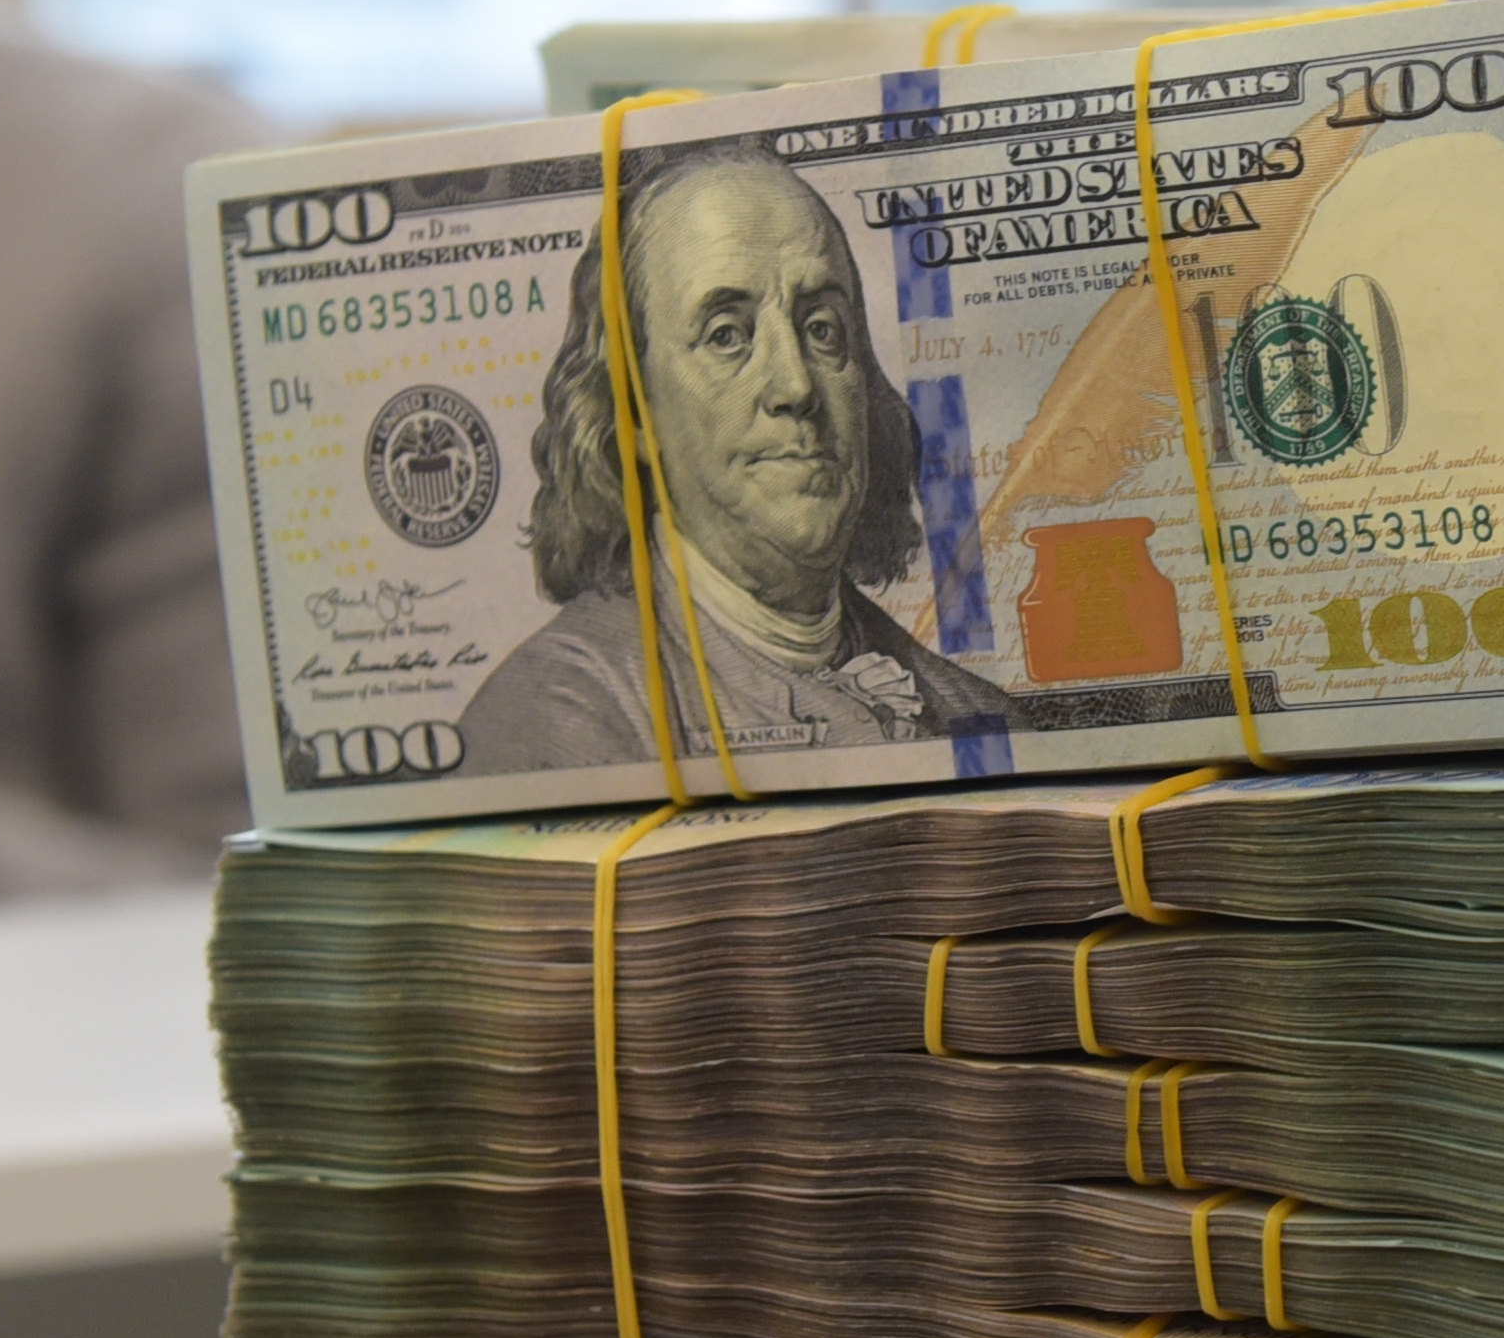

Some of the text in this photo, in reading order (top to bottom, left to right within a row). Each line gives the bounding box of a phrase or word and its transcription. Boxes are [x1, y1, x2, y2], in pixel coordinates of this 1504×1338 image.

[775, 70, 1291, 156] ONE HUNDRED DOLLARS
[1006, 130, 1139, 166] THE
[856, 137, 1305, 229] UNITED STATES
[240, 189, 395, 258] 100
[909, 221, 982, 268] OF
[256, 229, 584, 288] FEDERAL RESERVE NOTE
[994, 253, 1201, 288] THIS NOTE IS LEGAL TDER
[963, 293, 992, 307] FOR
[997, 288, 1024, 303] ALL
[1027, 283, 1080, 300] DEBTS,
[1084, 277, 1137, 293] PUBLIC
[1177, 263, 1237, 282] PRIVATE
[262, 275, 546, 345] MD 68353108 A
[909, 326, 967, 363] JULY
[269, 376, 314, 417] D4
[1268, 503, 1494, 561] 68353108
[1232, 614, 1273, 630] ERIES
[1236, 629, 1265, 644] 2013
[307, 719, 466, 781] 100
[726, 725, 806, 744] RANKLIN
